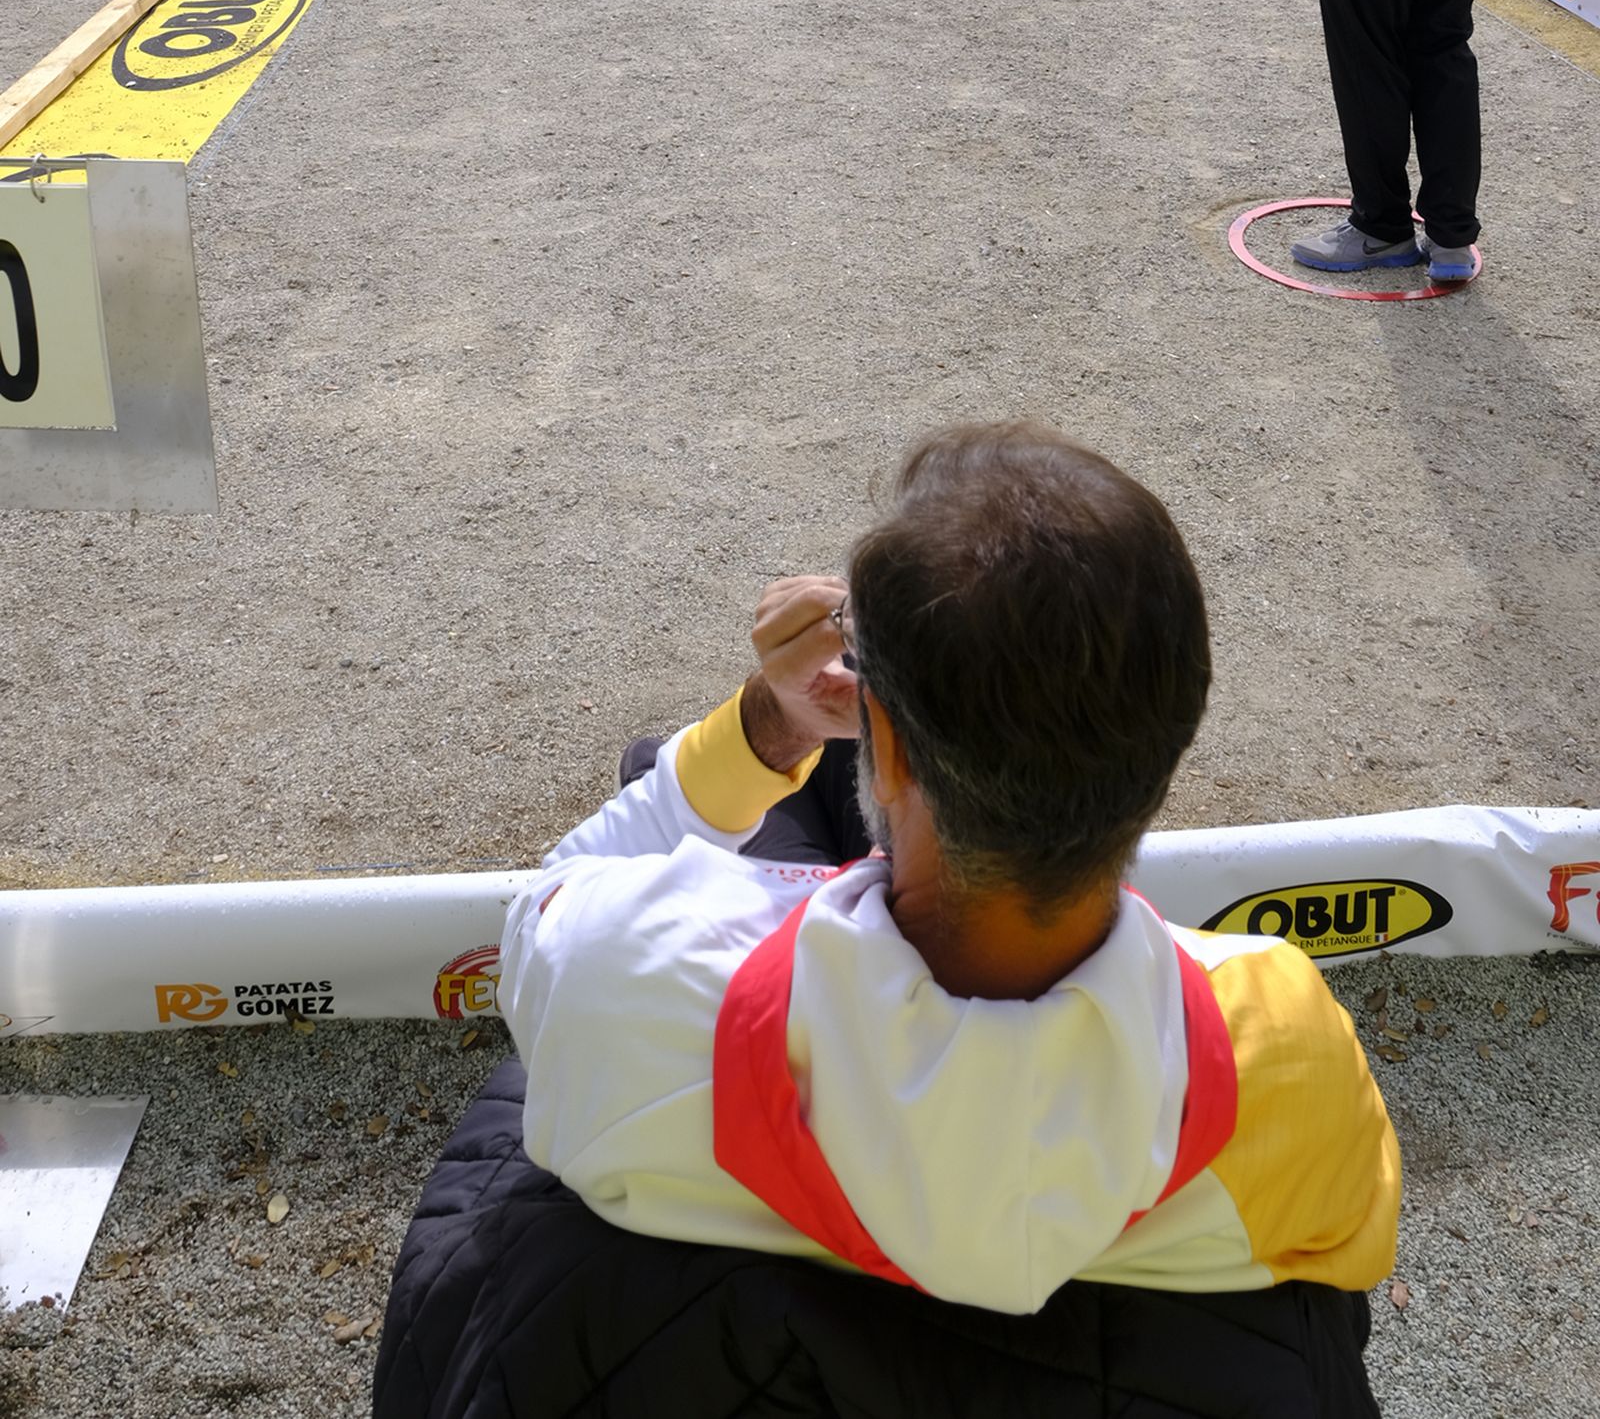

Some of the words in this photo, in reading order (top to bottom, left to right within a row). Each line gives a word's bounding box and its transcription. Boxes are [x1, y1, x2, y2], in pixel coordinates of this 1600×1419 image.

[1247, 886, 1396, 938] OBUT
[1300, 939, 1315, 949] EN
[1316, 934, 1372, 948] PÉTANQUE
[234, 980, 332, 997] PATATAS
[437, 973, 501, 1012] FE
[236, 996, 334, 1016] GÓMEZ
